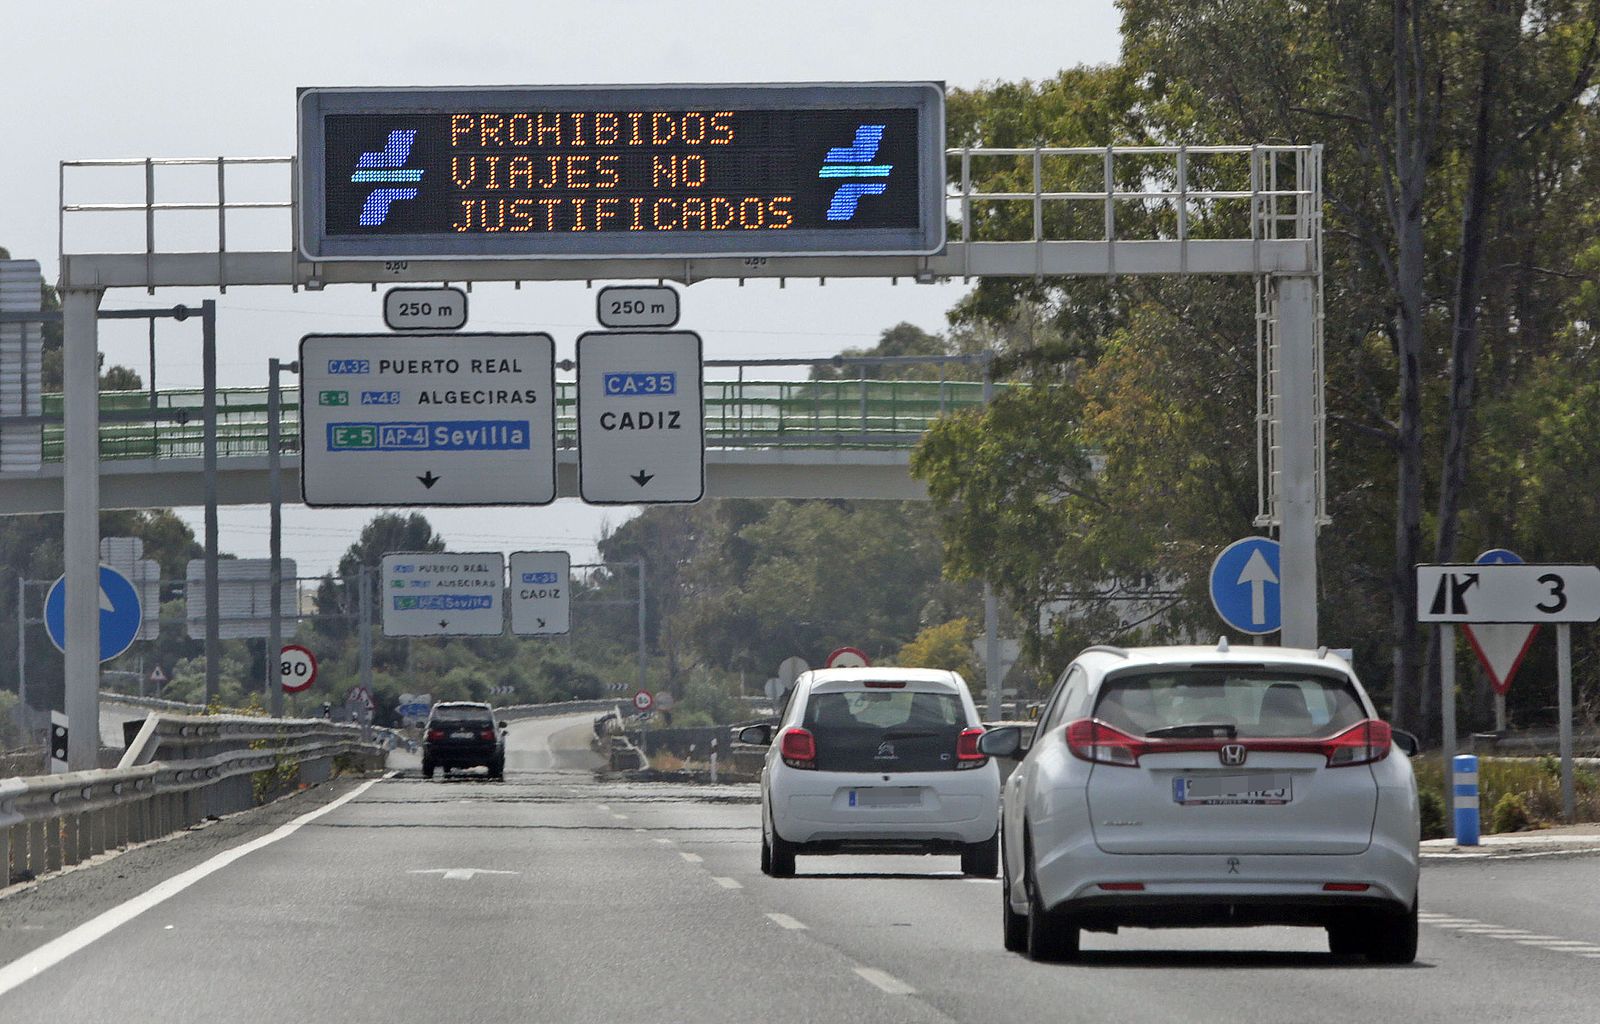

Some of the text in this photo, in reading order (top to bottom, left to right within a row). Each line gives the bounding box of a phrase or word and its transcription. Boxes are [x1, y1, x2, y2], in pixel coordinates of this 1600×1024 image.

[450, 111, 736, 147] PROHIBIDOS
[450, 153, 707, 190] VIAJES NO
[452, 196, 794, 232] JUSTIFICADOS
[399, 302, 453, 316] 250 m
[611, 300, 665, 315] 250 m
[328, 358, 522, 374] CA-32 PUERTO REAL
[606, 374, 673, 393] CA-35
[320, 390, 537, 405] E-5 A-48 ALGECIRAS
[600, 411, 681, 431] CADIZ
[335, 425, 524, 446] E-5 AP-4 Sevilla
[520, 589, 560, 600] CADIZ
[1535, 573, 1568, 614] 3
[281, 661, 307, 677] 80
